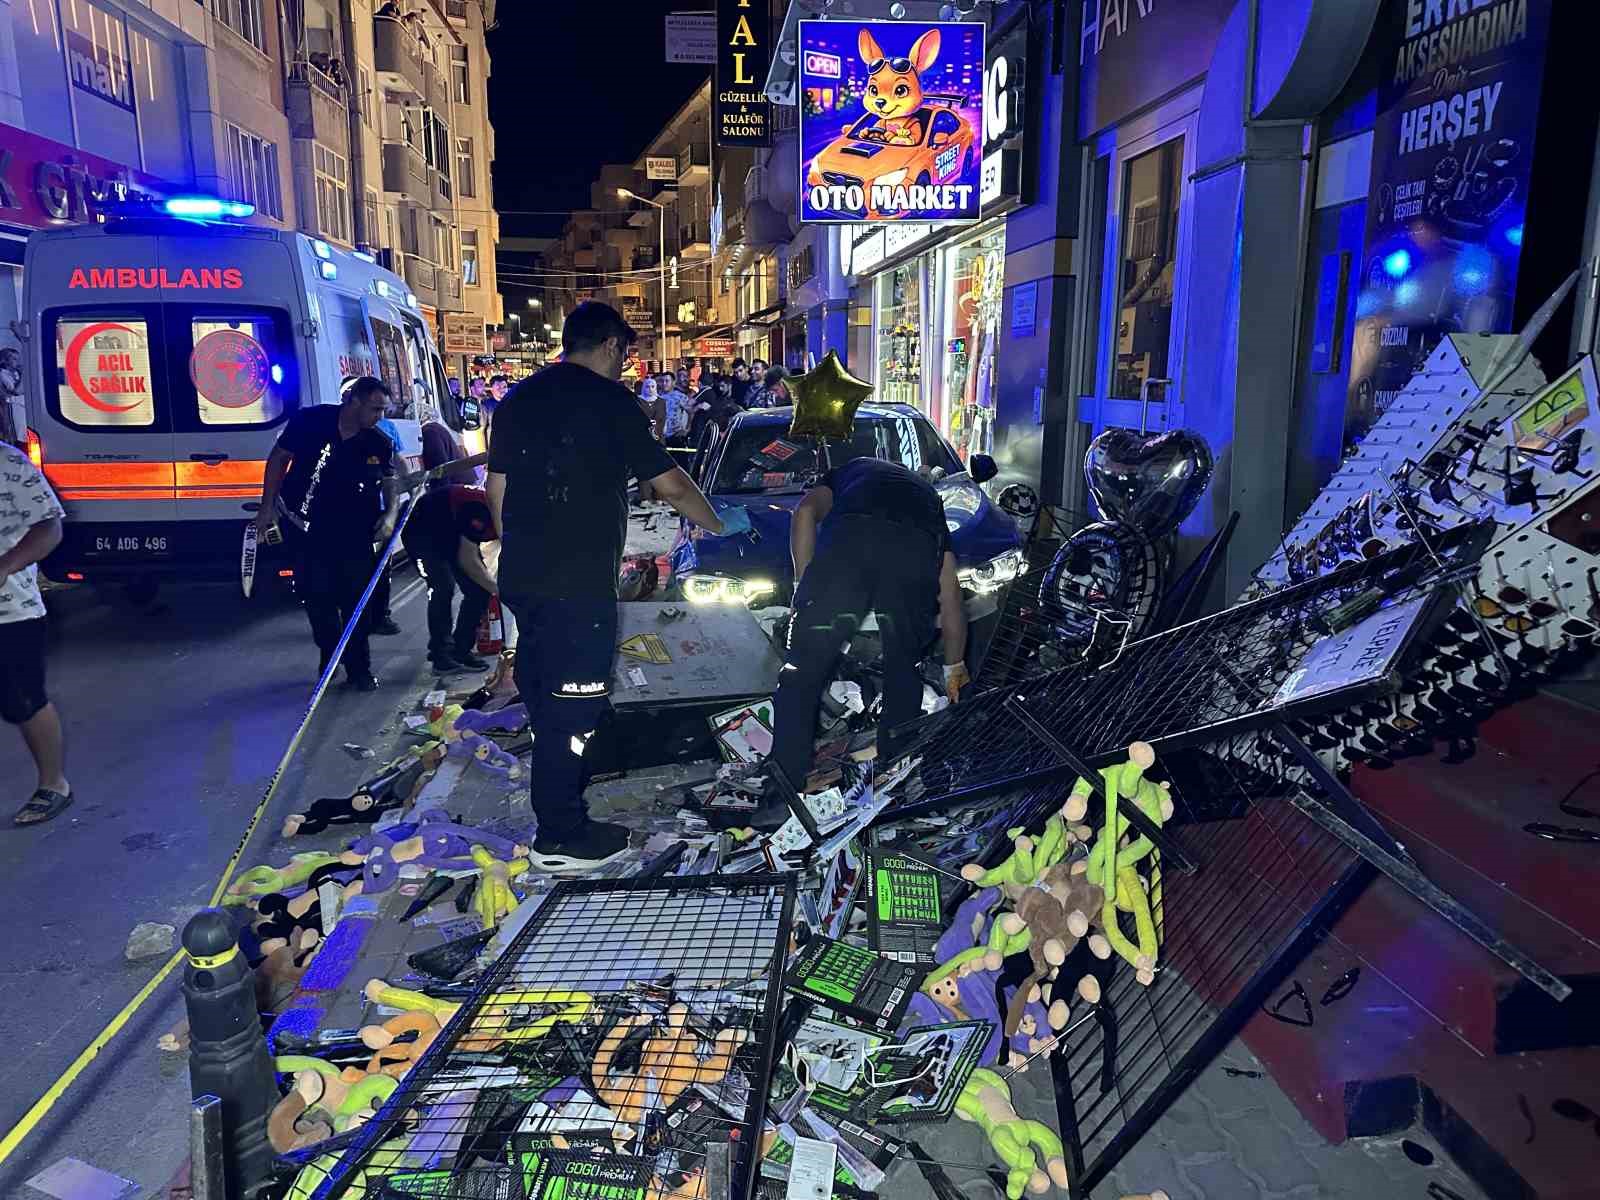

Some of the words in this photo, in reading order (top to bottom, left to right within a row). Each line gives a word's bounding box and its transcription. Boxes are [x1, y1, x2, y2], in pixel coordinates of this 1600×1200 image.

[808, 55, 838, 74] OPEN
[722, 113, 764, 125] KUAFÖR
[722, 126, 764, 137] SALONU
[935, 144, 961, 170] STREET
[938, 159, 958, 180] KING
[810, 185, 865, 211] OTO
[870, 184, 973, 210] MARKET
[69, 268, 244, 289] AMBULANS
[97, 351, 134, 372] ACİL
[88, 371, 146, 394] SAĞLIK
[96, 537, 112, 551] 64
[145, 537, 167, 550] 496
[883, 858, 906, 869] GOGO
[565, 1161, 600, 1176] GOGO
[600, 1170, 635, 1182] PREMIUM
